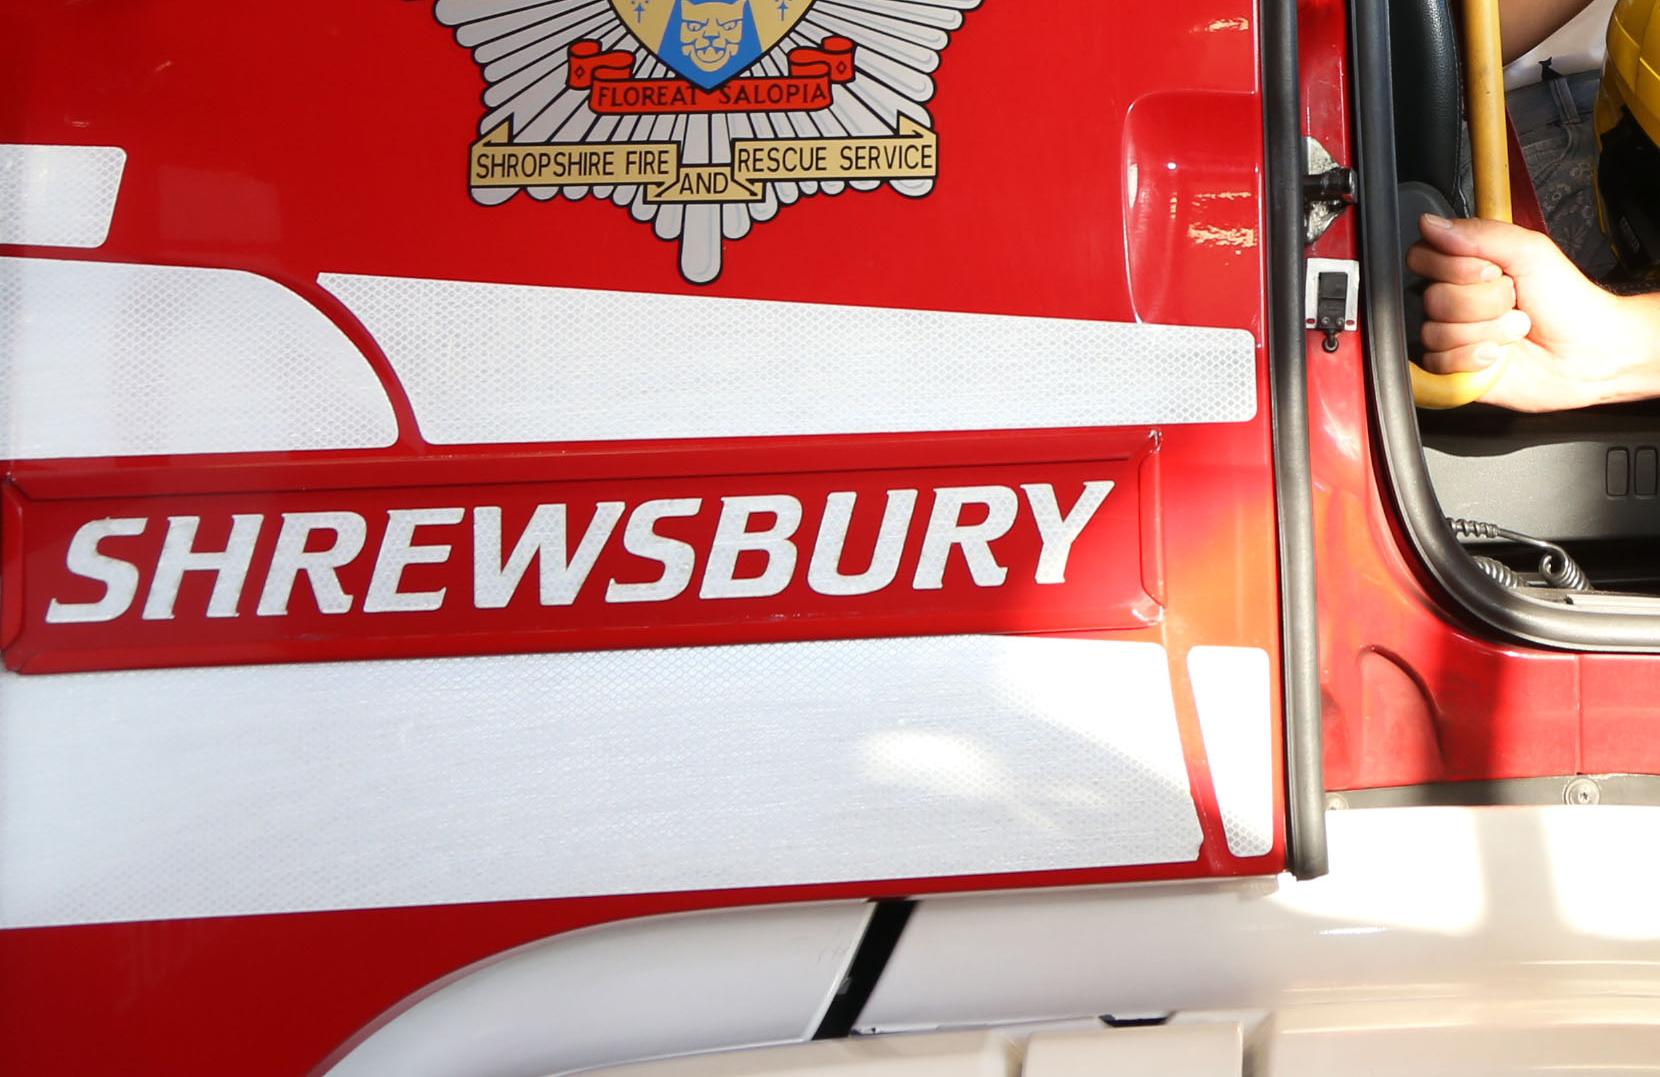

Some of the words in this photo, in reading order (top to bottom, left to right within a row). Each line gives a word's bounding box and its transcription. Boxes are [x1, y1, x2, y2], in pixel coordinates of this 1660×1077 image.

[598, 84, 699, 108] FLOREAT
[717, 82, 828, 106] SALOPIA
[475, 150, 615, 179] SHROPSHIRE
[624, 149, 671, 175] FIRE
[679, 172, 730, 196] AND
[737, 146, 828, 173] RESCUE
[839, 144, 934, 171] SERVICE
[45, 479, 1116, 625] SHREWSBURY
